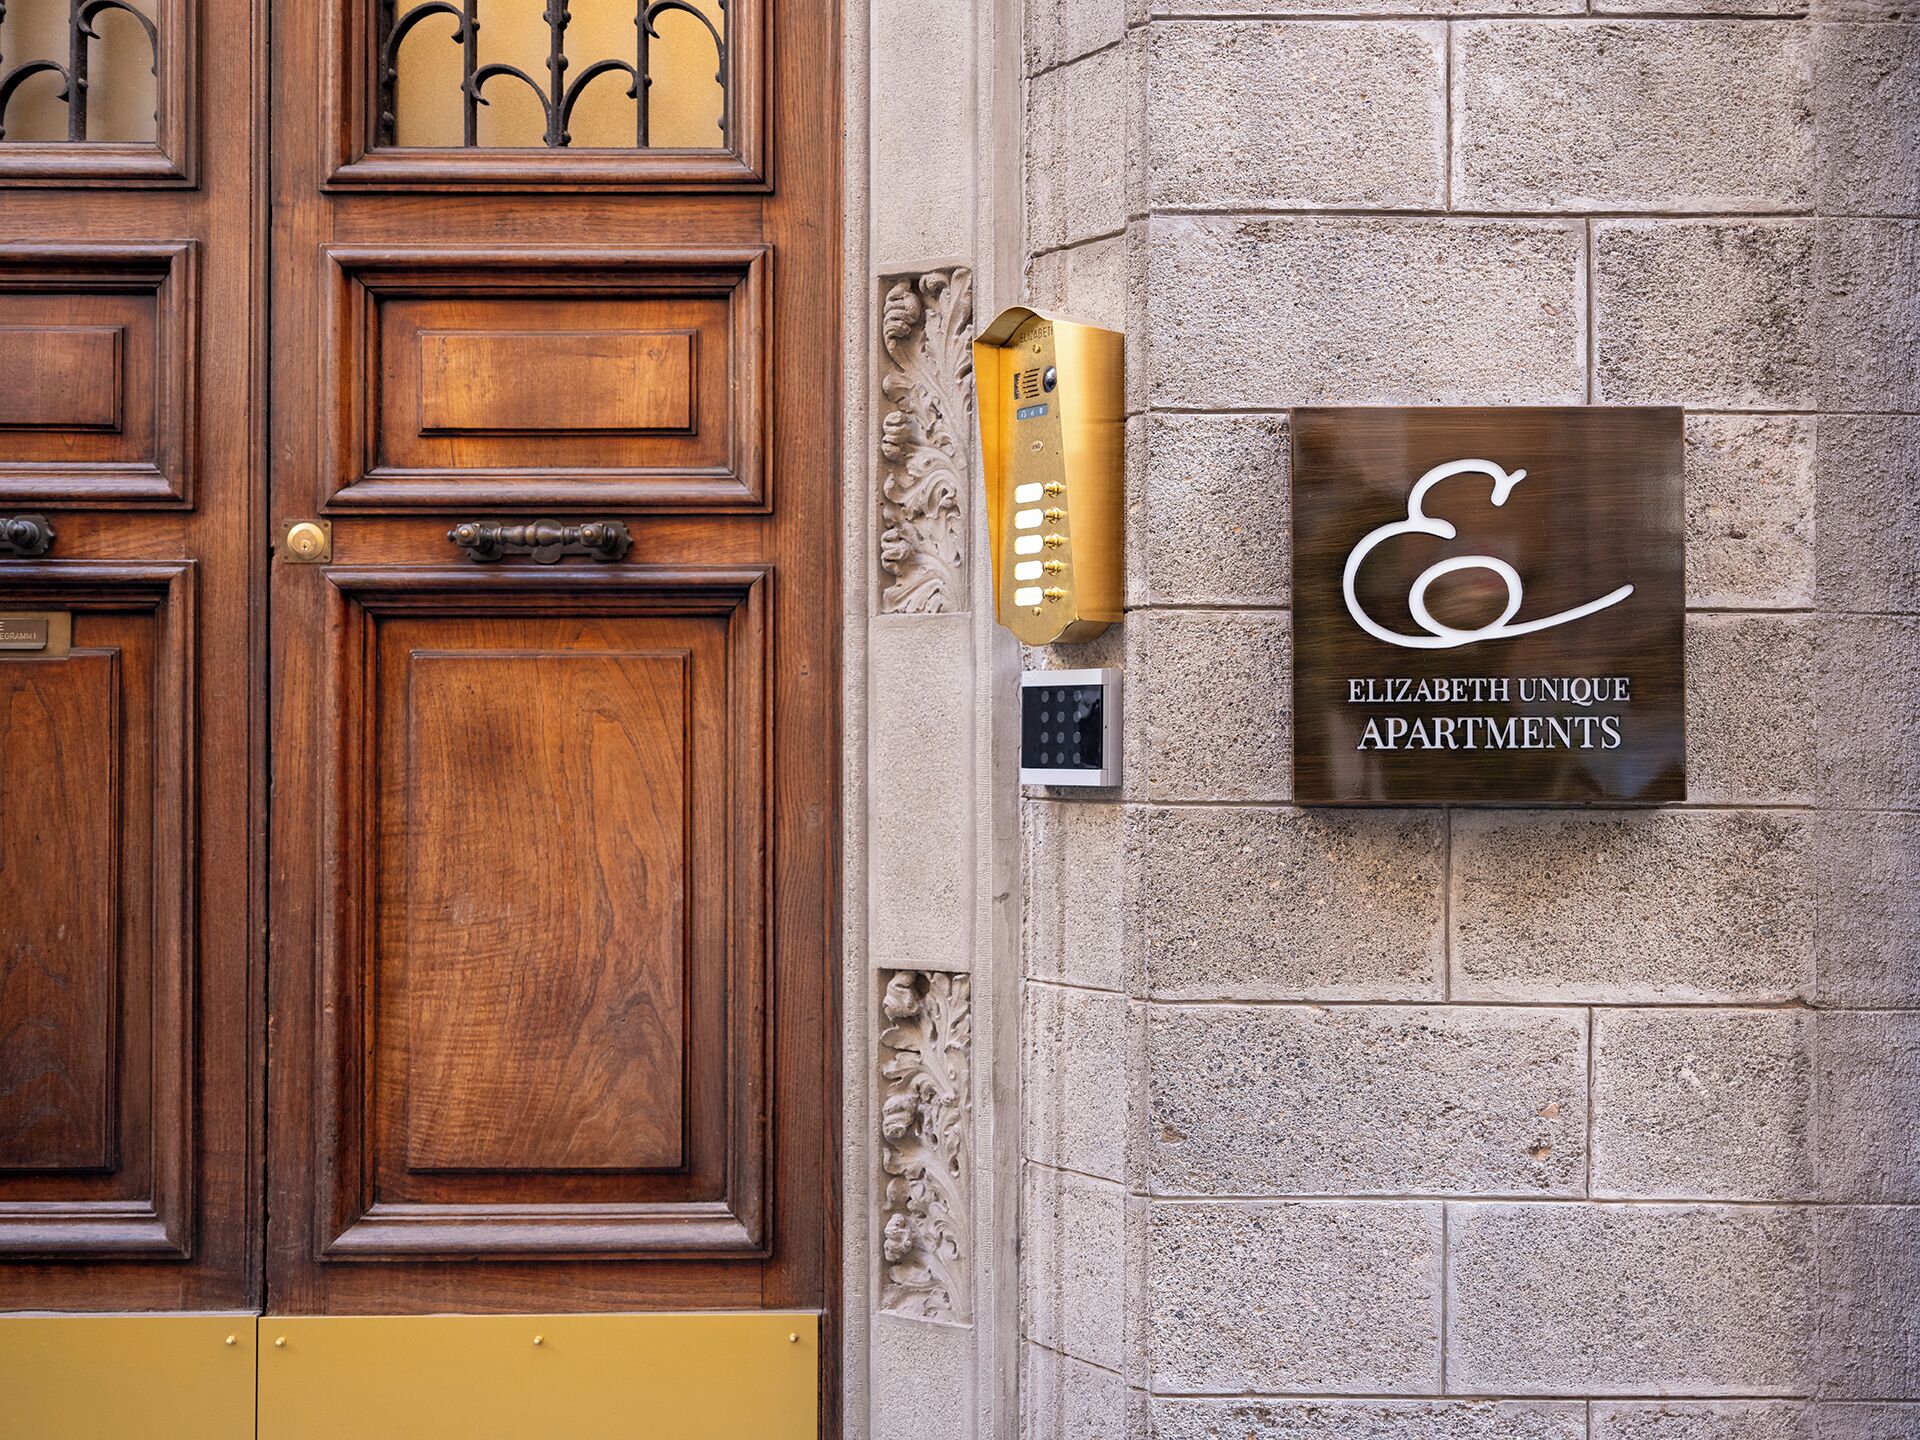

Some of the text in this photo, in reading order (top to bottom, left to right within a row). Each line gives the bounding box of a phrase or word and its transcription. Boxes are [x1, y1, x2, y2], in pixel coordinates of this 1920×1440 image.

[1347, 677, 1630, 707] ELIZABETH UNIQUE
[1356, 716, 1622, 750] APARTMENTS
